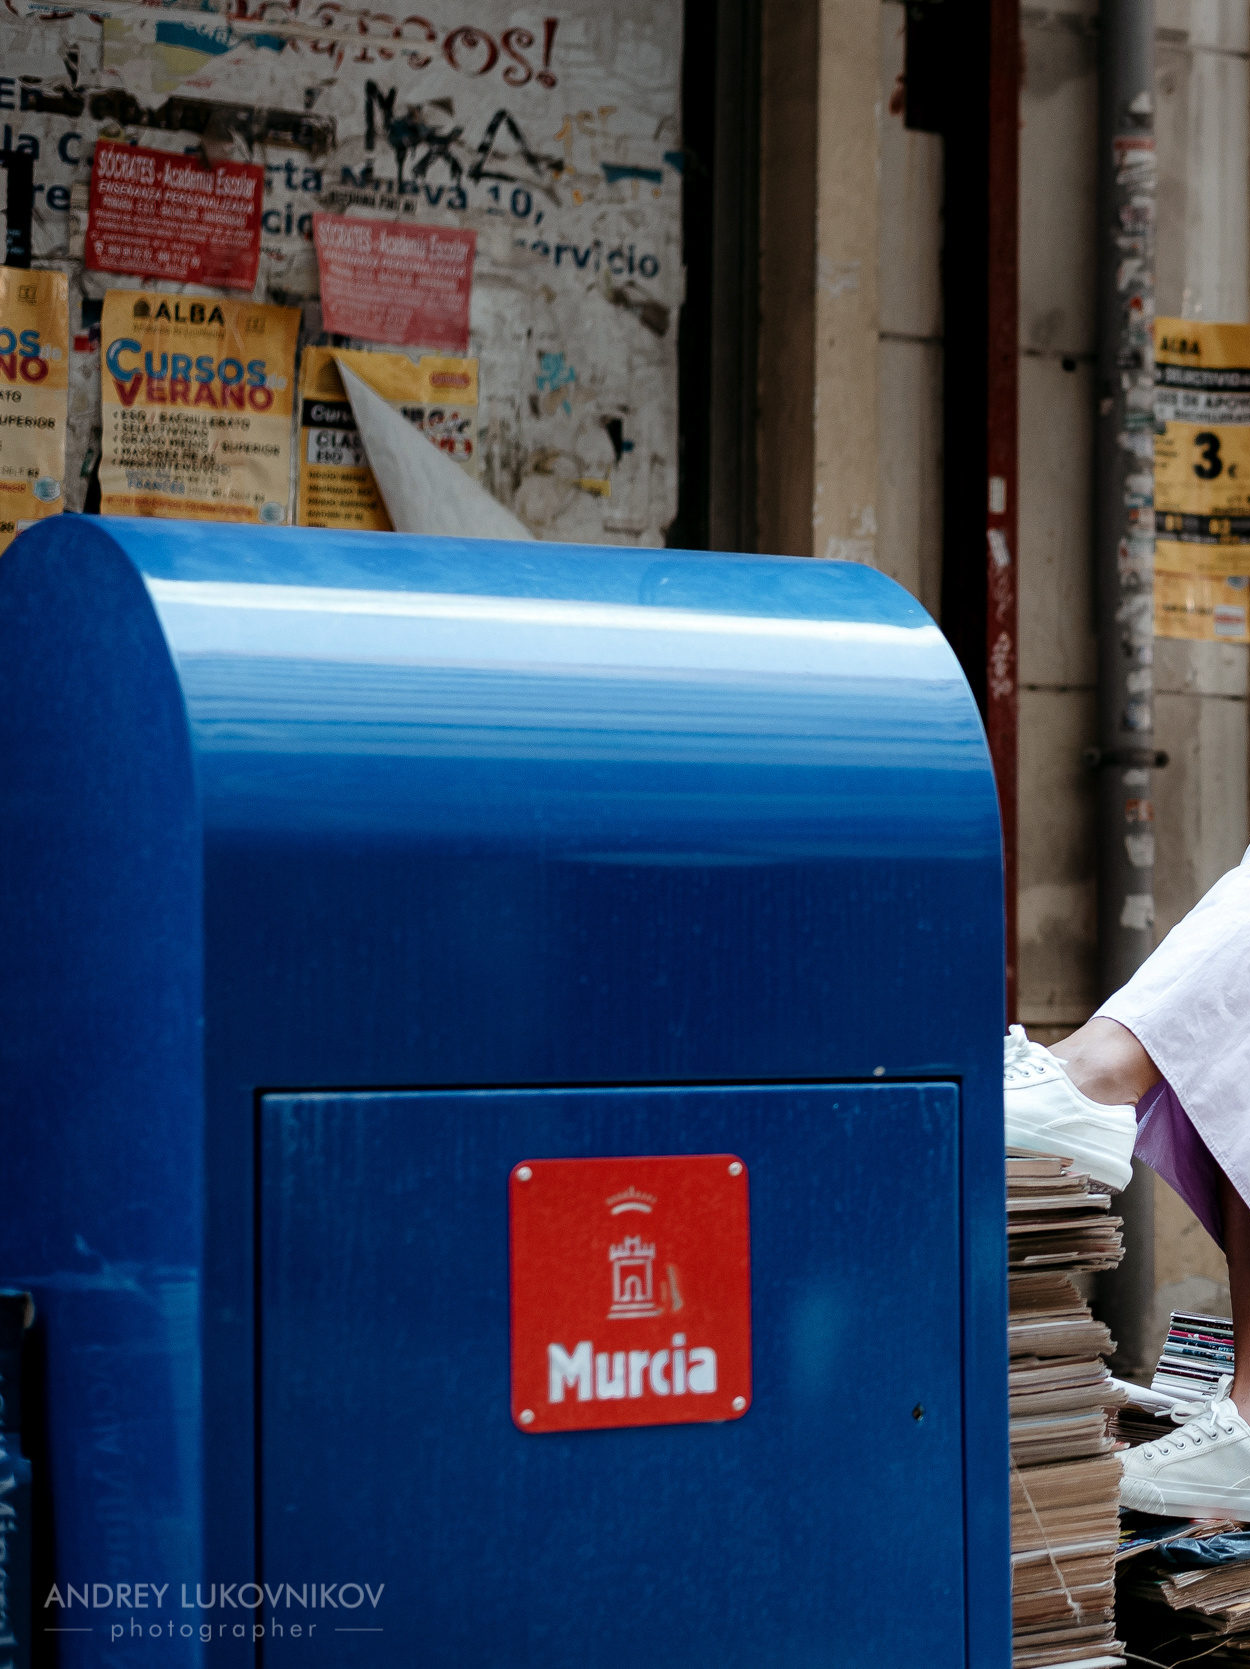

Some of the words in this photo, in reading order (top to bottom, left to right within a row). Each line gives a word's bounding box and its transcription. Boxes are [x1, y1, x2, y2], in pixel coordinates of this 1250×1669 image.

[155, 302, 225, 326] ALBA
[1159, 336, 1200, 355] ALBA
[113, 373, 275, 411] VERANO
[1193, 431, 1223, 480] 3
[548, 1333, 717, 1403] Murcia
